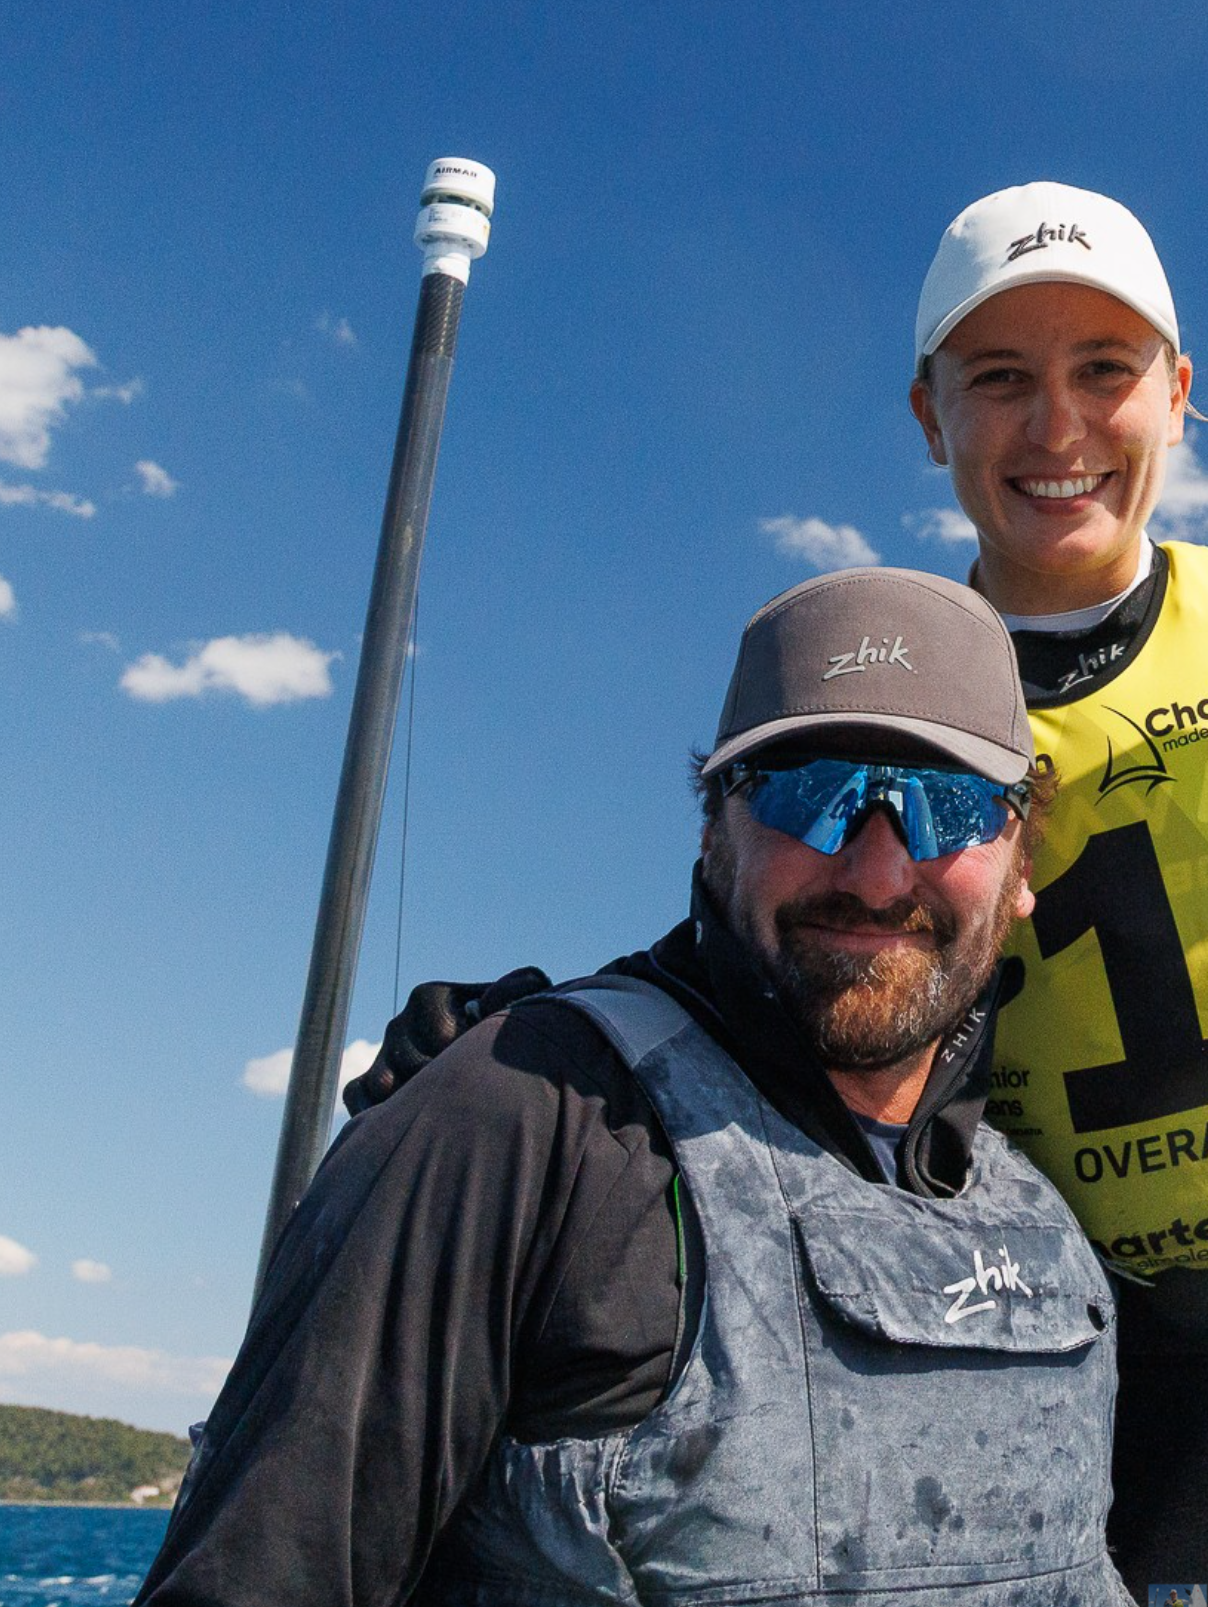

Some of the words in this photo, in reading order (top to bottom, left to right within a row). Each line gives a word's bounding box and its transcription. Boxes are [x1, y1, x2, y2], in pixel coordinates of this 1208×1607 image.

[941, 1007, 986, 1063] ZHIK
[990, 1066, 1030, 1088] nior
[987, 1099, 1024, 1117] ans
